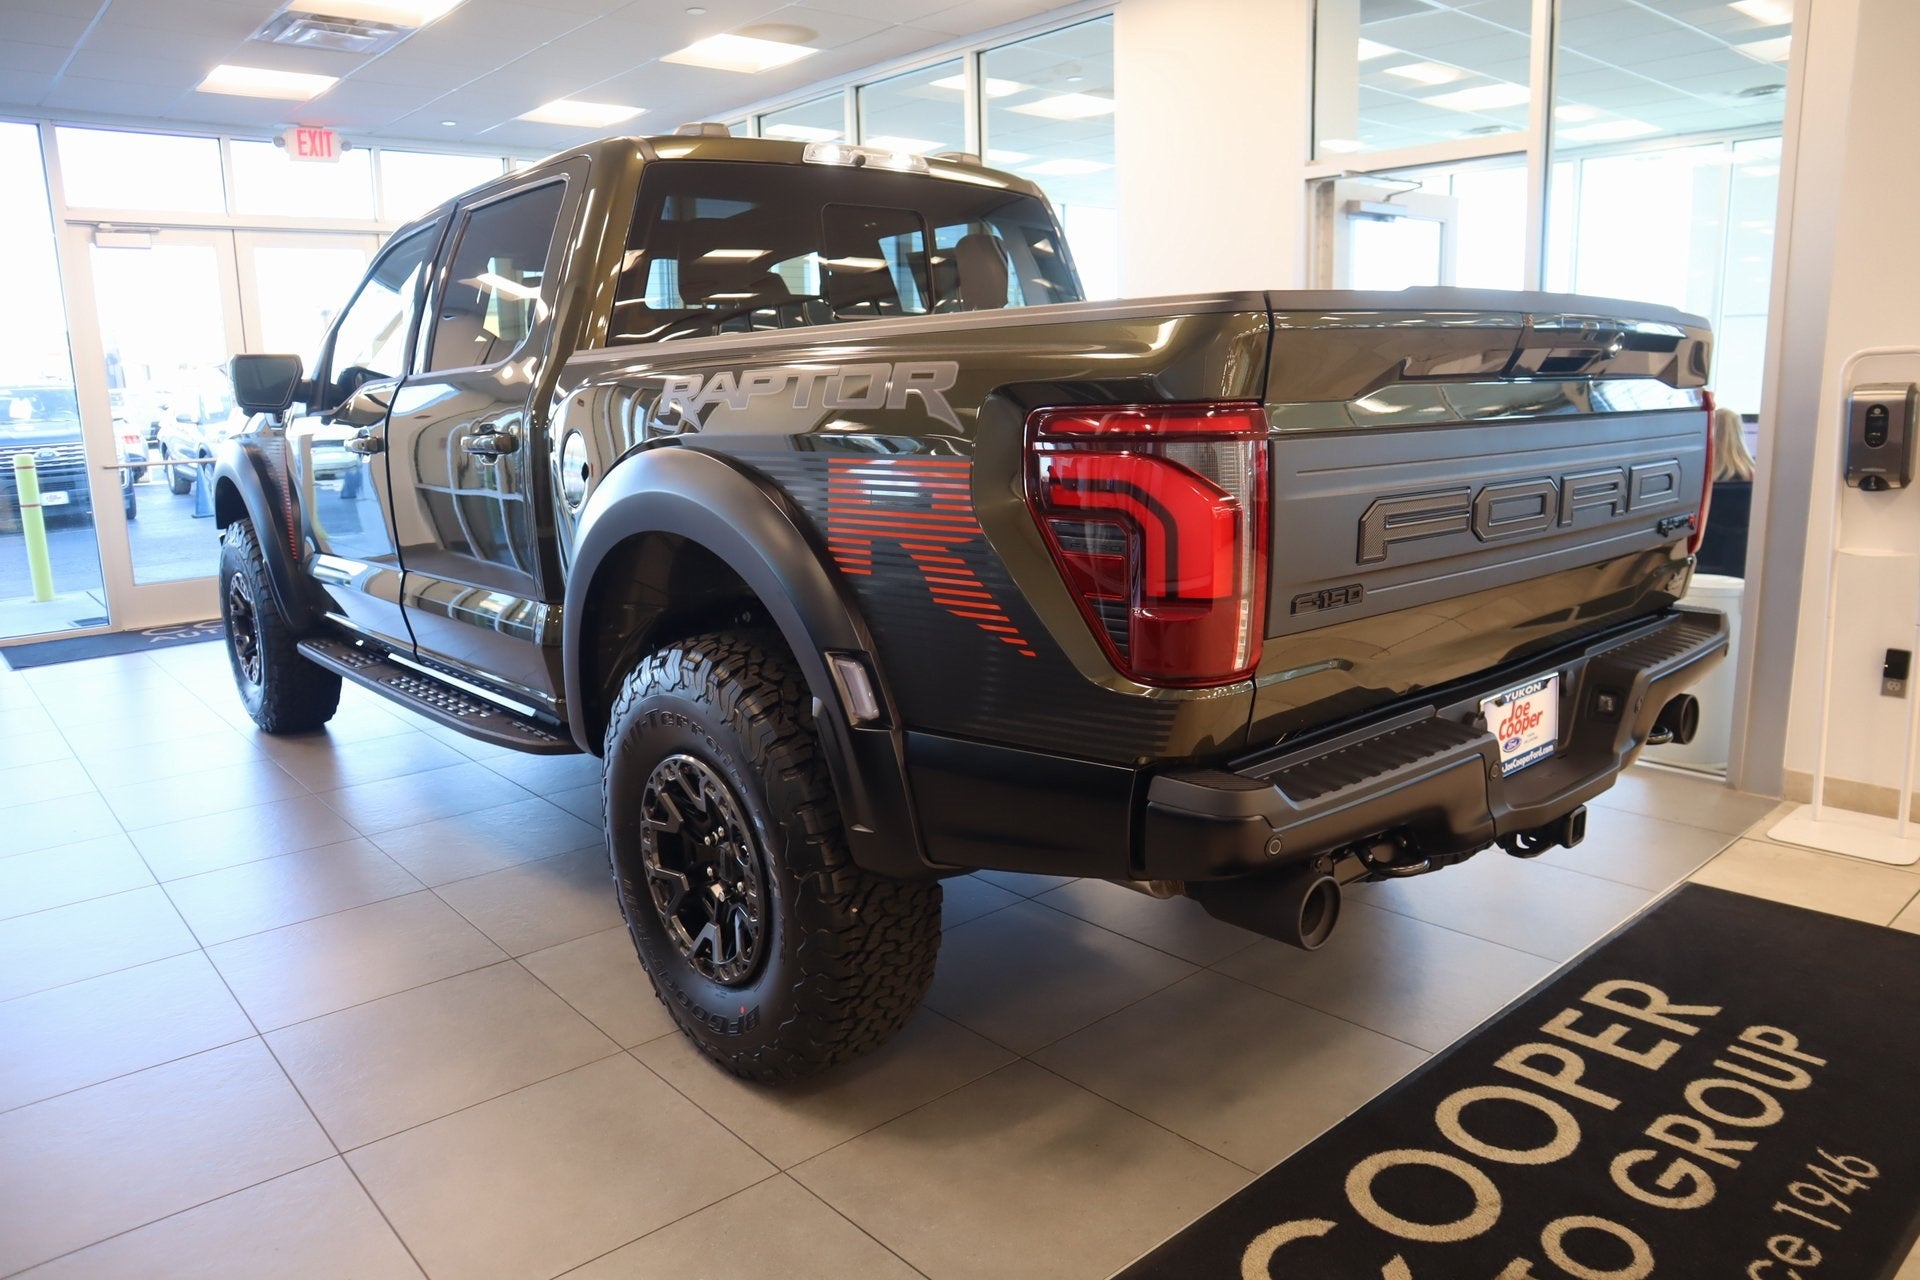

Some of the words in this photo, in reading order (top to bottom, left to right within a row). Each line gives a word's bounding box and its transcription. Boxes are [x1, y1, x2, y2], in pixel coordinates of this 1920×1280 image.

[296, 129, 333, 157] EXIT
[658, 361, 964, 433] RAPTOR
[1357, 457, 1681, 566] FORD
[1504, 682, 1542, 702] YUKON
[1508, 700, 1531, 723] Joe
[1498, 711, 1543, 741] Cooper
[1609, 1025, 1828, 1210] GROUP
[1772, 1146, 1880, 1231] 1946
